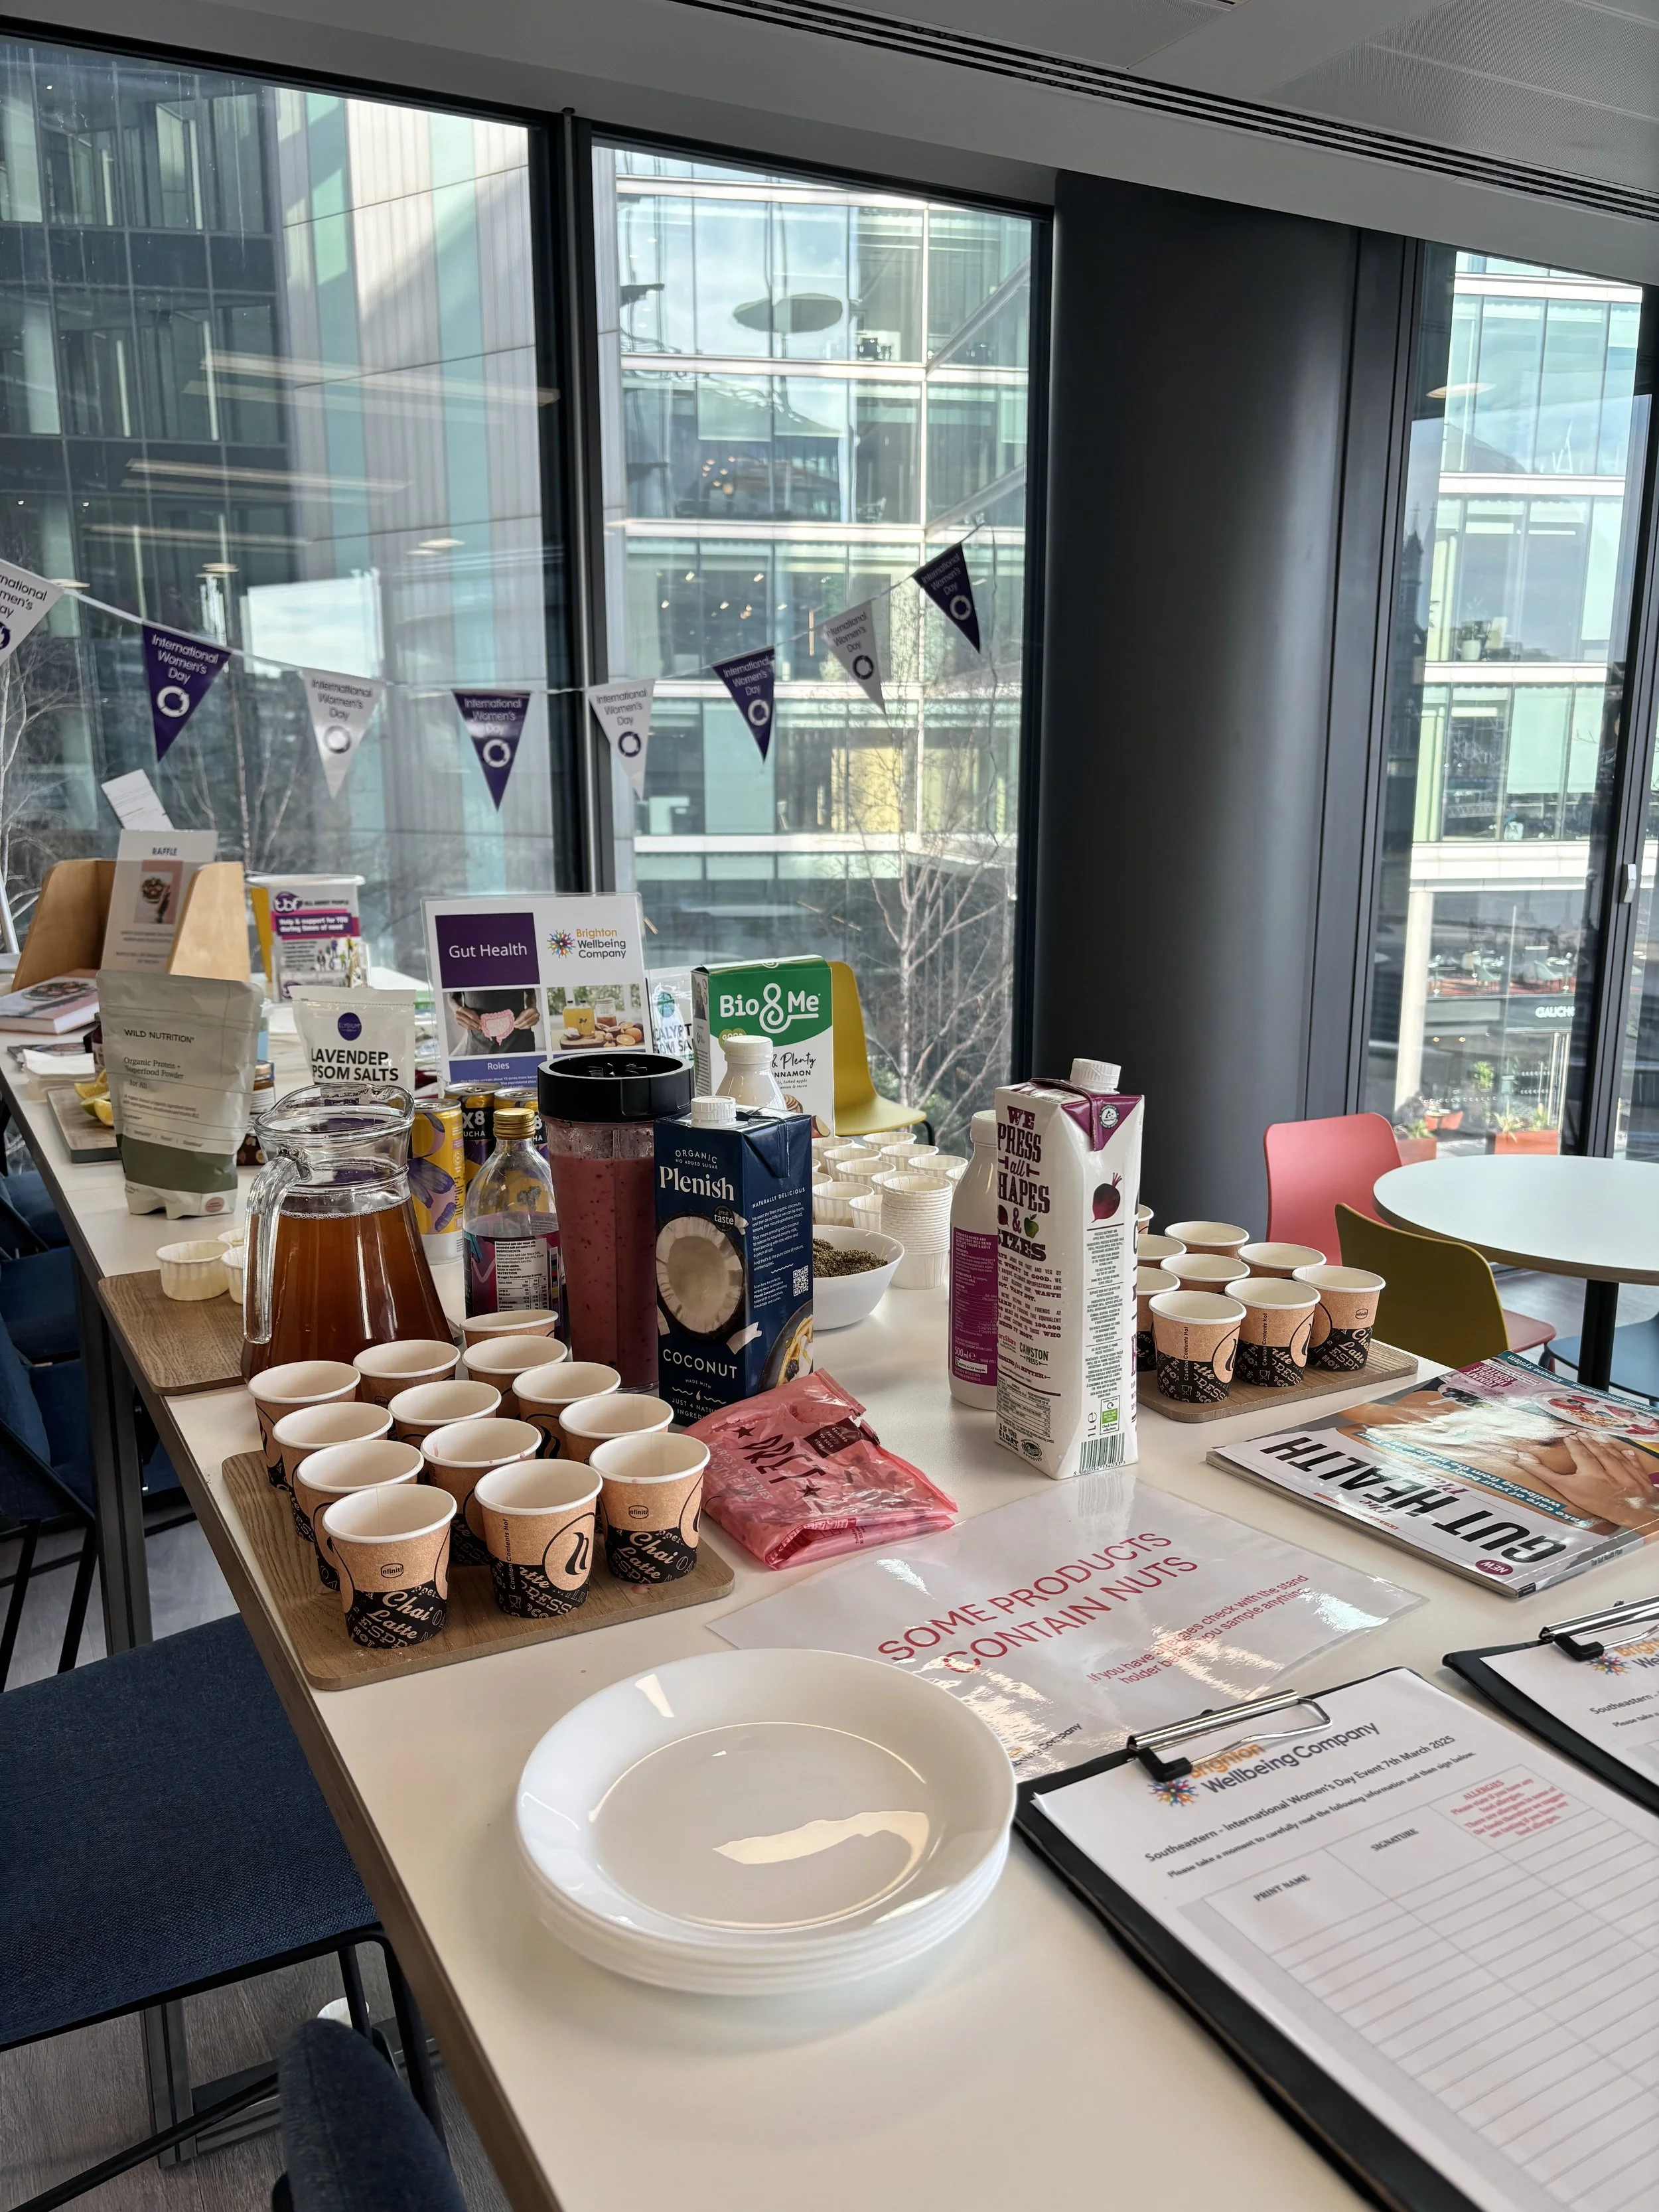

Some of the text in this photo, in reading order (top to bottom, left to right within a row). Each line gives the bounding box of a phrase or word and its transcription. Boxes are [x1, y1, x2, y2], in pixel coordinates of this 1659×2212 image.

[921, 553, 960, 585] International
[930, 567, 962, 591] Women's
[942, 582, 958, 595] Day
[832, 625, 867, 647] Women's
[151, 633, 220, 665] International
[846, 640, 861, 653] Day
[157, 650, 208, 676] Women's
[723, 654, 770, 678] International
[167, 667, 191, 685] Day
[732, 669, 768, 688] Women's
[311, 678, 373, 699] International
[597, 688, 647, 704] International
[745, 684, 762, 696] Day
[317, 692, 364, 709] Women's
[464, 698, 522, 709] International
[604, 701, 643, 715] Women's
[328, 707, 350, 722] Day
[472, 710, 516, 721] Women's
[616, 715, 634, 727] Day
[485, 723, 504, 735] Day
[151, 846, 178, 857] RAFFLE
[575, 928, 618, 940] Brighton
[449, 942, 528, 958] Gut Health
[577, 938, 627, 950] Wellbeing
[578, 948, 627, 960] Company
[123, 1029, 147, 1038] WILD
[123, 1057, 151, 1067] Organic
[780, 1052, 817, 1069] Plenty
[124, 1065, 184, 1079] Superfood Powder
[312, 1065, 399, 1082] PSOM SALTS
[1007, 1105, 1036, 1131] WE
[997, 1122, 1042, 1163] PRESS
[675, 1149, 717, 1164] ORGANIC
[1010, 1159, 1026, 1177] all
[659, 1165, 735, 1201] Plenish
[752, 1187, 806, 1209] NATURALLY DELICIOUS
[713, 1214, 735, 1225] taste
[1011, 1207, 1022, 1234] &
[1034, 1289, 1062, 1299] WASTE
[1019, 1341, 1049, 1361] CAWSTON
[663, 1348, 738, 1379] COCONUT
[1025, 1355, 1039, 1366] PRESS
[1507, 1354, 1534, 1372] system
[1463, 1370, 1494, 1388] TUMMY
[1471, 1366, 1506, 1386] TROUBLE
[1479, 1364, 1514, 1382] SORTED!
[1532, 1367, 1564, 1383] Immune
[1571, 1382, 1622, 1402] microbiomes
[672, 1398, 687, 1406] JUST
[696, 1404, 717, 1414] NATU
[677, 1408, 705, 1420] INGRED
[1621, 1399, 1653, 1412] Healthy
[738, 1434, 827, 1485] PRET
[1428, 1459, 1451, 1470] and
[1451, 1461, 1472, 1471] the
[1261, 1436, 1460, 1516] HEALTH
[1450, 1468, 1482, 1483] body
[1471, 1469, 1501, 1483] from
[734, 1483, 758, 1501] MIX
[1480, 1479, 1512, 1493] your
[1500, 1480, 1561, 1509] wellbeing
[1359, 1499, 1394, 1516] The
[1526, 1497, 1554, 1512] care
[1441, 1509, 1568, 1564] GUT
[1481, 1561, 1510, 1574] NEW
[382, 1590, 435, 1621] Chai
[878, 1532, 1173, 1661] SOME PRODUCTS
[943, 1556, 1198, 1674] CONTAIN NUTS
[366, 1609, 418, 1640] Latte
[1086, 1574, 1309, 1684] If you have allergies check with the stand
[1118, 1662, 1164, 1685] holder
[1201, 1627, 1223, 1644] you
[1218, 1607, 1263, 1633] sample
[1589, 1694, 1654, 1715] Southeastern
[1612, 1718, 1638, 1728] Please
[1200, 1721, 1382, 1794] Wellbeing Company
[1144, 1734, 1457, 1863] Southeastern International Women's Day Event 7th March 2025
[1166, 1863, 1195, 1878] Please
[1194, 1856, 1216, 1872] take
[1222, 1841, 1257, 1860] moment
[1255, 1835, 1266, 1846] to
[1265, 1821, 1300, 1842] carefully
[1299, 1812, 1319, 1828] read
[1318, 1808, 1331, 1820] the
[1329, 1794, 1366, 1814] following
[1361, 1778, 1409, 1802] information
[1406, 1773, 1421, 1785] and
[1420, 1765, 1439, 1779] then
[1437, 1761, 1455, 1775] sign
[1453, 1751, 1477, 1765] below.
[1370, 1827, 1419, 1852] SIGNATURE
[1253, 1874, 1311, 1902] PRINT NAME
